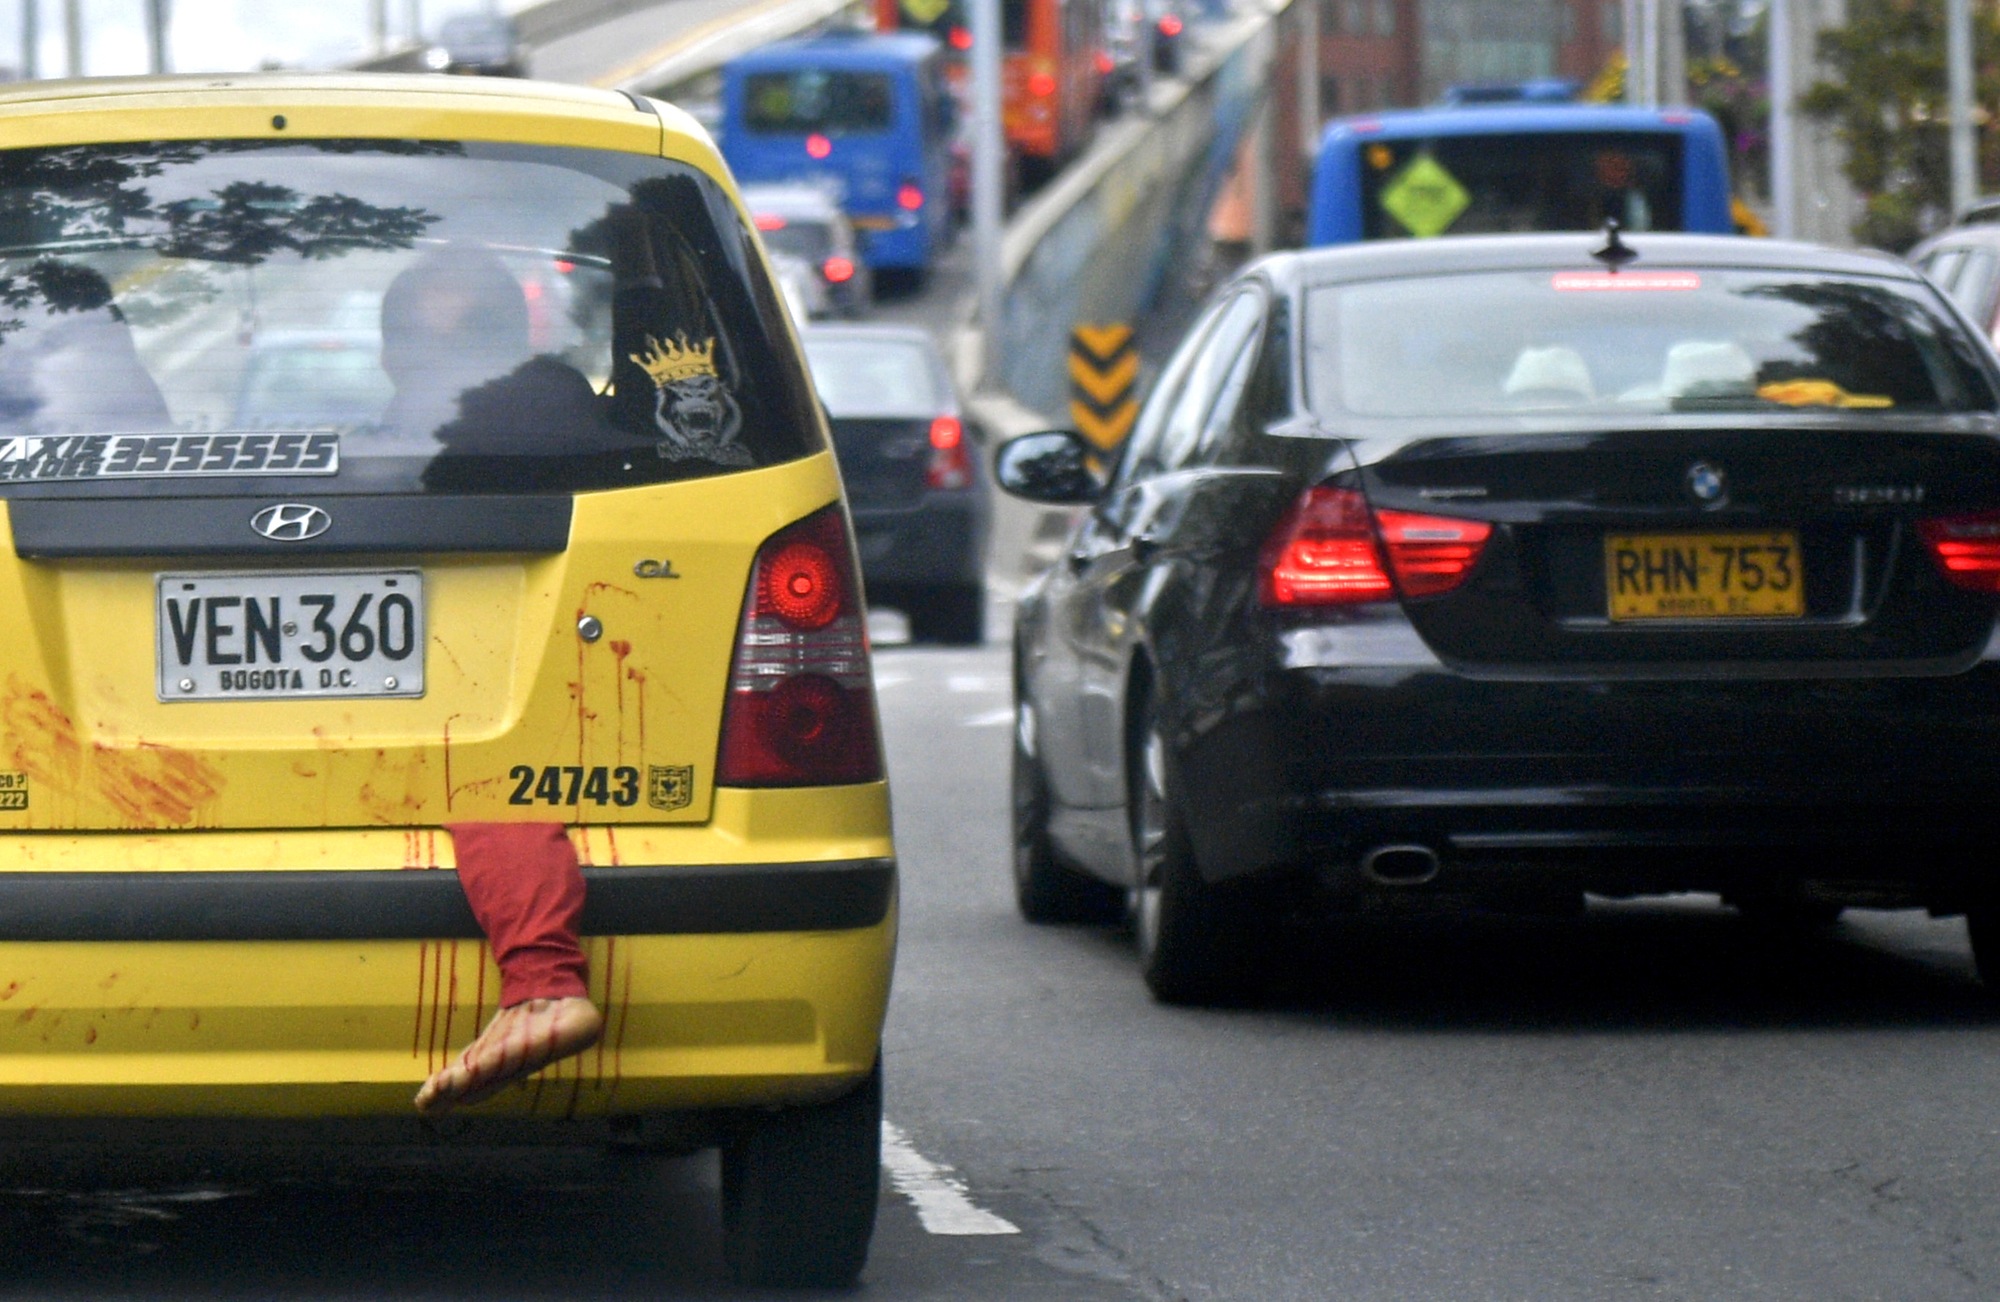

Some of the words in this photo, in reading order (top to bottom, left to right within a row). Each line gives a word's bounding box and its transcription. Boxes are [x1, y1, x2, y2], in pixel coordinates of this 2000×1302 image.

[105, 434, 338, 473] 3555555
[167, 597, 282, 666] VEN
[300, 593, 415, 662] 360
[220, 669, 303, 690] BOGOTA
[319, 668, 358, 688] D.C.
[508, 765, 639, 807] 24743
